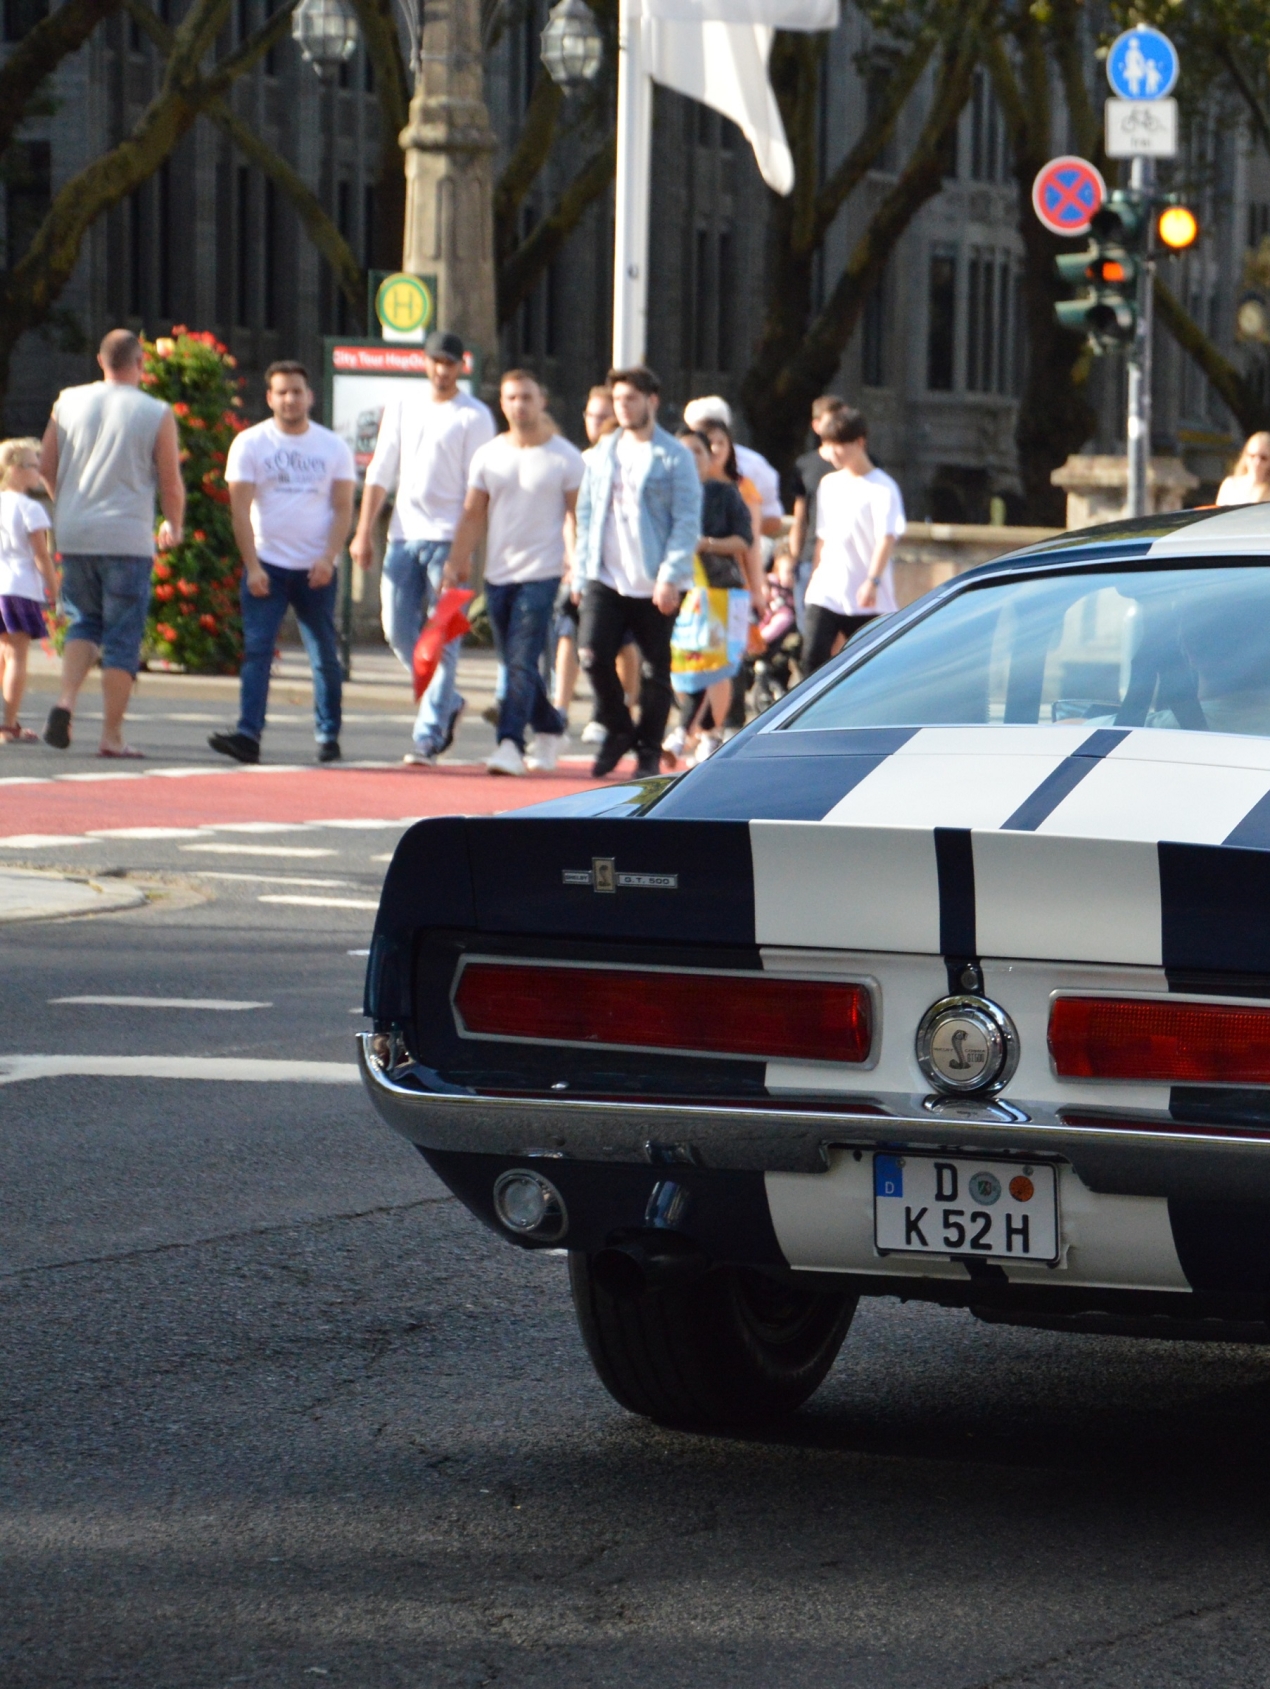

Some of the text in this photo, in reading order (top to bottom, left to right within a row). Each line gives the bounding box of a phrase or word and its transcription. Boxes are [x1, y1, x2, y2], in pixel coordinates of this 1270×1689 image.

[393, 290, 413, 319] H
[885, 1181, 895, 1194] D
[934, 1162, 958, 1202] D
